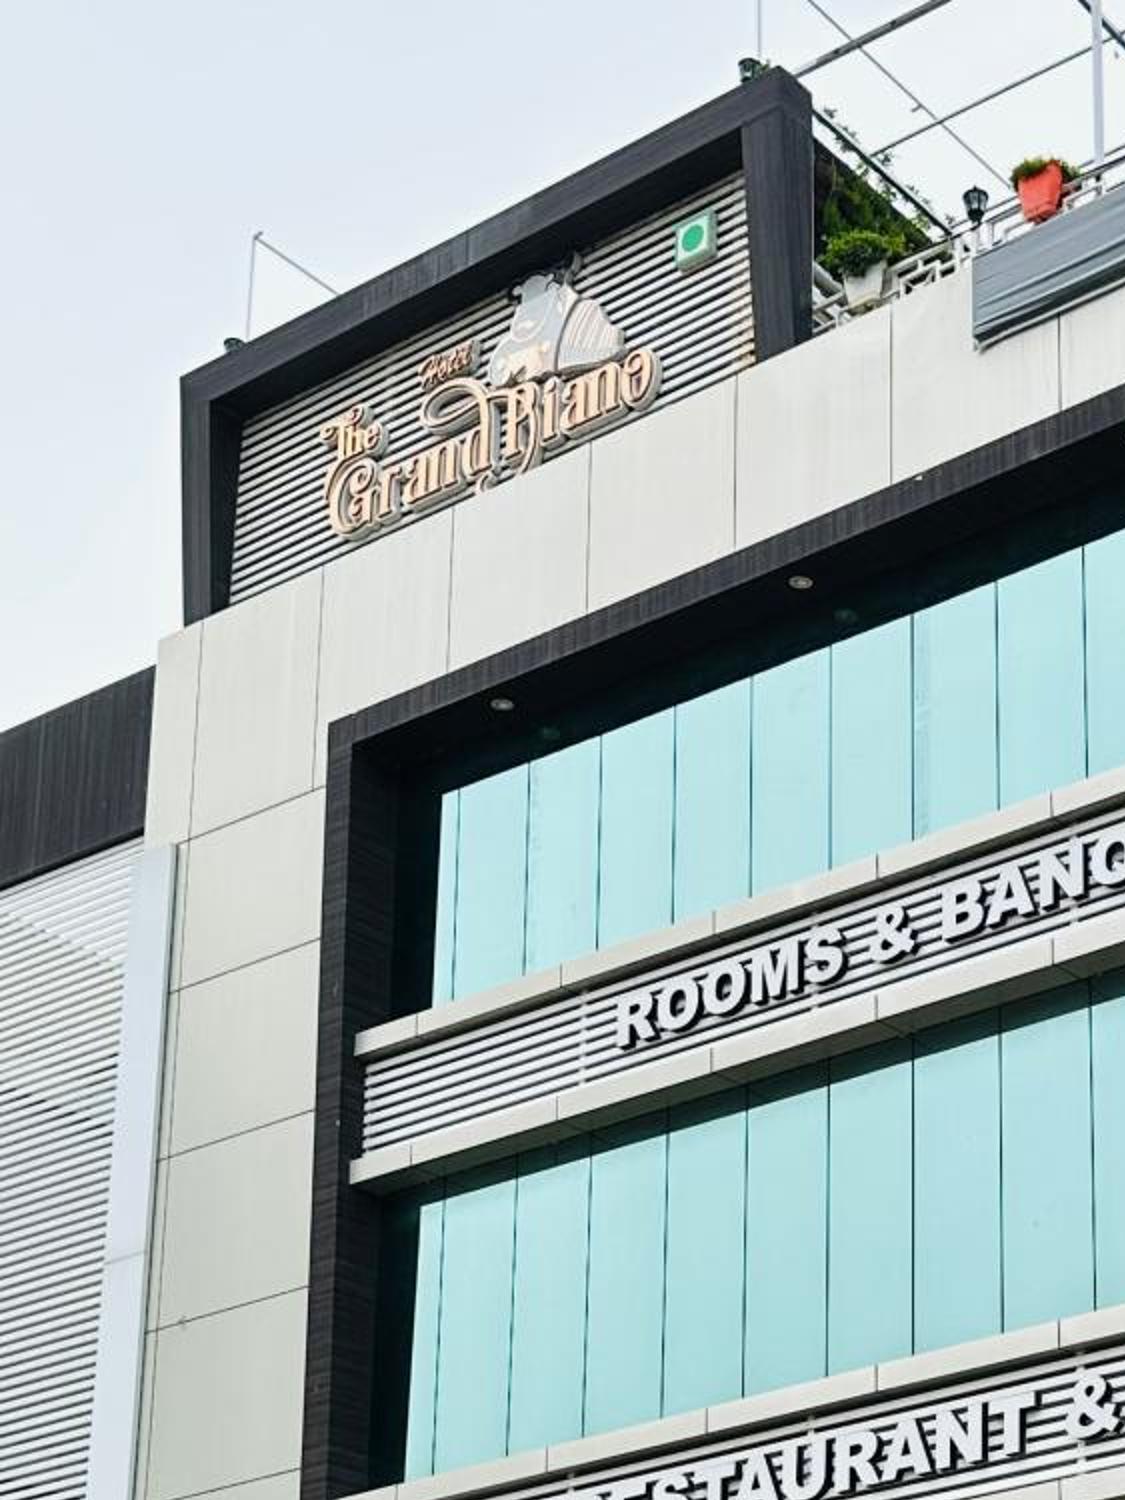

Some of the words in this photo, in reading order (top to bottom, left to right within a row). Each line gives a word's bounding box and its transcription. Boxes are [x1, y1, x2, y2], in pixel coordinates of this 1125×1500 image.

[320, 402, 381, 460] The
[324, 378, 494, 535] Grand
[476, 349, 656, 496] Piano
[614, 924, 848, 1049] ROOMS
[868, 904, 918, 964] &
[1065, 1372, 1124, 1440] &
